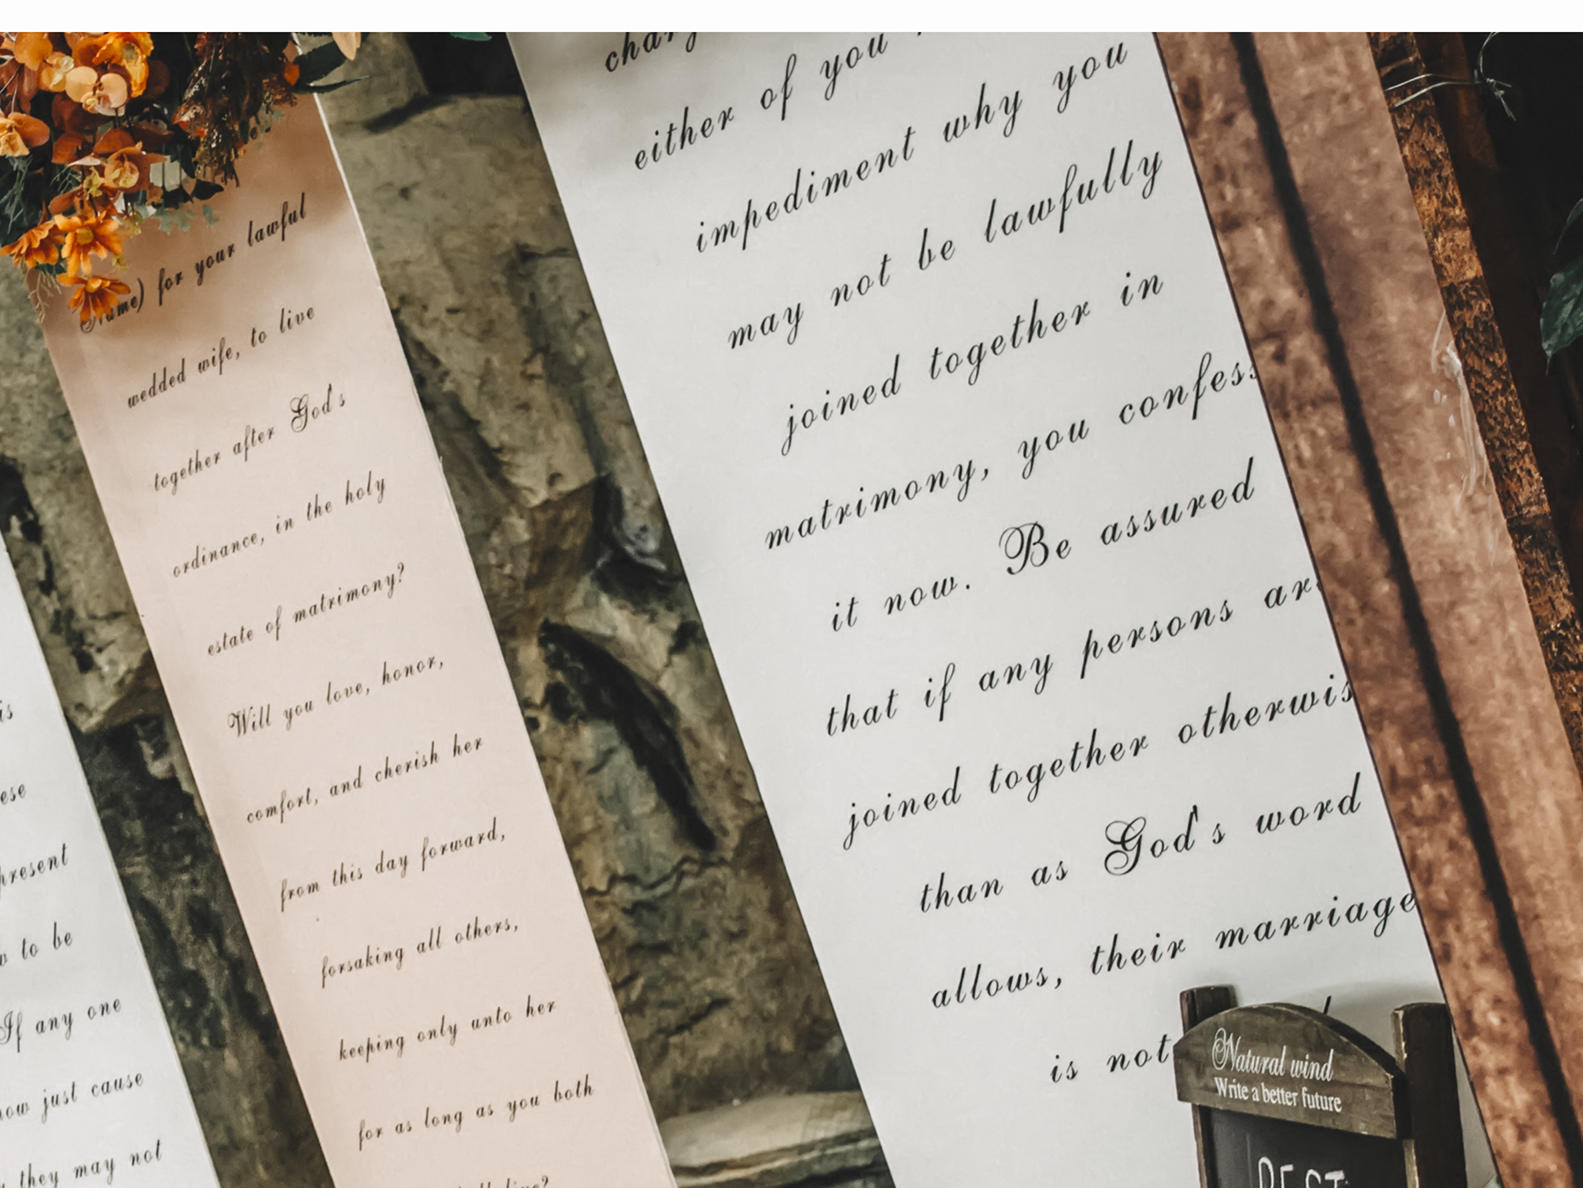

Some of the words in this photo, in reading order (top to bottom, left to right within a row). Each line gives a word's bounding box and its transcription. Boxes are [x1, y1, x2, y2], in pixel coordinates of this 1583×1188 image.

[634, 105, 735, 171] either
[759, 52, 798, 122] of
[819, 32, 889, 102] you
[695, 125, 917, 254] impediment
[942, 81, 1024, 144] why
[1051, 41, 1129, 115] you
[157, 267, 184, 307] for
[194, 243, 236, 287] your
[247, 191, 306, 248] lawful
[727, 301, 805, 351] may
[829, 253, 892, 308] not
[917, 226, 956, 272] be
[983, 138, 1163, 244] lawfully
[127, 357, 186, 409] wedded
[250, 327, 268, 348] to
[279, 306, 315, 334] live
[780, 352, 902, 457] joined
[928, 297, 1092, 387] together
[1119, 271, 1164, 308] in
[153, 448, 221, 496] together
[232, 424, 275, 463] after
[764, 458, 990, 550] matrimony,
[1017, 418, 1090, 481] you
[275, 515, 293, 535] in
[306, 493, 332, 522] the
[344, 470, 386, 506] holy
[831, 596, 860, 633] it
[883, 575, 971, 616] now.
[997, 520, 1072, 576] Be
[1099, 455, 1256, 547] assured
[207, 625, 254, 657] estate
[265, 605, 282, 642] of
[825, 688, 900, 737] that
[923, 661, 957, 723] if
[978, 653, 1054, 696] any
[1079, 599, 1234, 680] persons
[228, 703, 271, 737] Will
[283, 700, 313, 731] you
[329, 764, 364, 798] and
[374, 740, 439, 783] cherish
[452, 732, 483, 758] her
[842, 765, 962, 852] joined
[988, 727, 1149, 804] together
[919, 871, 1005, 914] than
[1030, 859, 1069, 887] as
[1103, 803, 1227, 877] God's
[1255, 770, 1362, 835] word
[280, 879, 320, 913] from
[332, 861, 363, 887] this
[374, 849, 409, 879] day
[21, 937, 39, 961] to
[52, 920, 73, 951] be
[321, 944, 405, 990] forsaking
[416, 925, 442, 955] all
[931, 962, 1063, 1009] allows,
[1089, 932, 1187, 976] their
[1215, 889, 1417, 949] marriage
[35, 1011, 74, 1041] any
[86, 998, 122, 1021] one
[339, 1035, 405, 1064] keeping
[416, 1014, 458, 1047] only
[470, 1006, 512, 1031] unto
[525, 994, 556, 1019] her
[1212, 1027, 1287, 1077] Natural
[1290, 1048, 1334, 1082] wind
[1049, 1053, 1079, 1084] is
[1106, 1033, 1172, 1073] not
[41, 1080, 78, 1124] just
[90, 1072, 143, 1097] cause
[358, 1119, 383, 1152] for
[394, 1120, 413, 1135] as
[424, 1106, 463, 1133] long
[475, 1103, 495, 1119] as
[506, 1095, 541, 1123] you
[553, 1073, 593, 1103] both
[1214, 1077, 1249, 1101] Write
[1252, 1086, 1260, 1102] a
[1261, 1082, 1298, 1107] better
[1301, 1086, 1343, 1113] future
[72, 1157, 115, 1186] may
[129, 1138, 161, 1167] not
